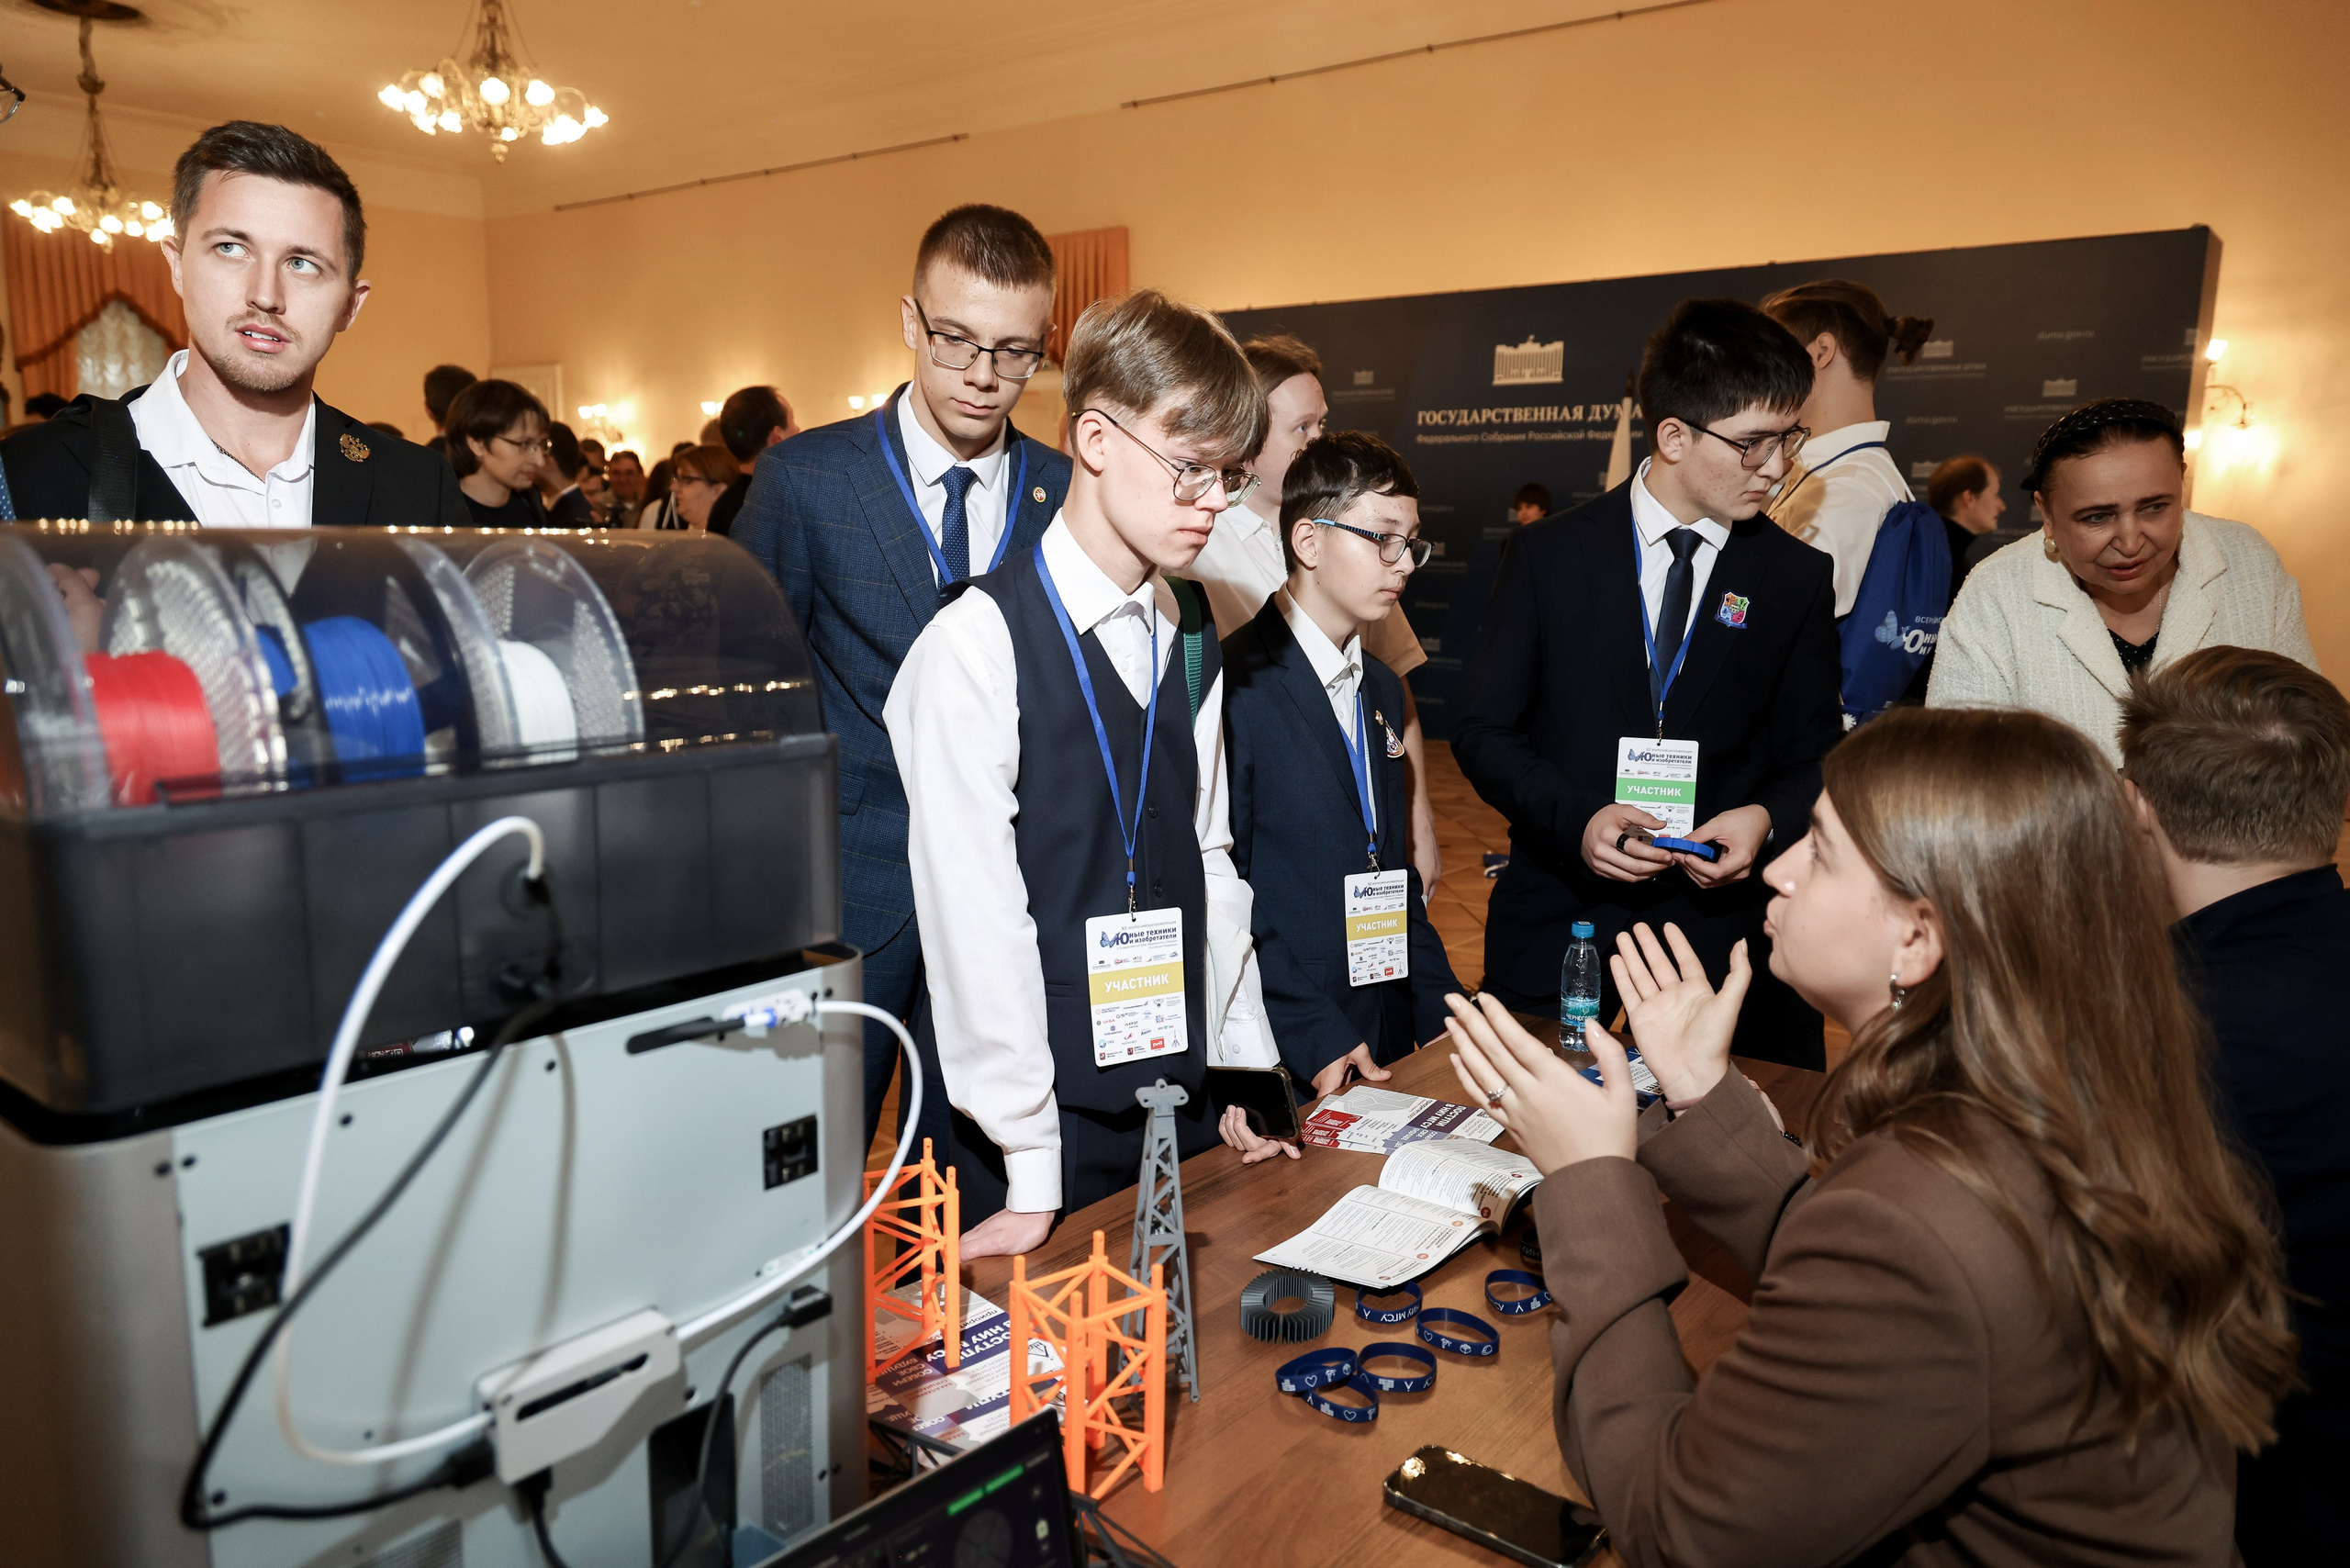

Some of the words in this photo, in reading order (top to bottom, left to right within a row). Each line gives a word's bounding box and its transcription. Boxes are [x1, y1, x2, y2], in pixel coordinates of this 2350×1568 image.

[1417, 405, 1584, 427] ГОСУДАРСТВЕННАЯ
[1481, 431, 1527, 442] Собрания
[1528, 430, 1586, 442] Российской
[1627, 785, 1682, 797] УЧАСТНИК
[1146, 927, 1177, 936] техники
[1356, 918, 1398, 933] УЧАСТНИК
[1135, 934, 1177, 943] изобретатели
[1104, 973, 1169, 993] УЧАСТНИК
[1380, 1311, 1406, 1323] МГСУ
[1407, 1305, 1420, 1317] НИУ
[971, 1325, 1004, 1344] НИУ
[897, 1363, 925, 1376] СВОЕ
[892, 1368, 934, 1386] СОБЕРИ
[912, 1416, 946, 1432] СОБЕР
